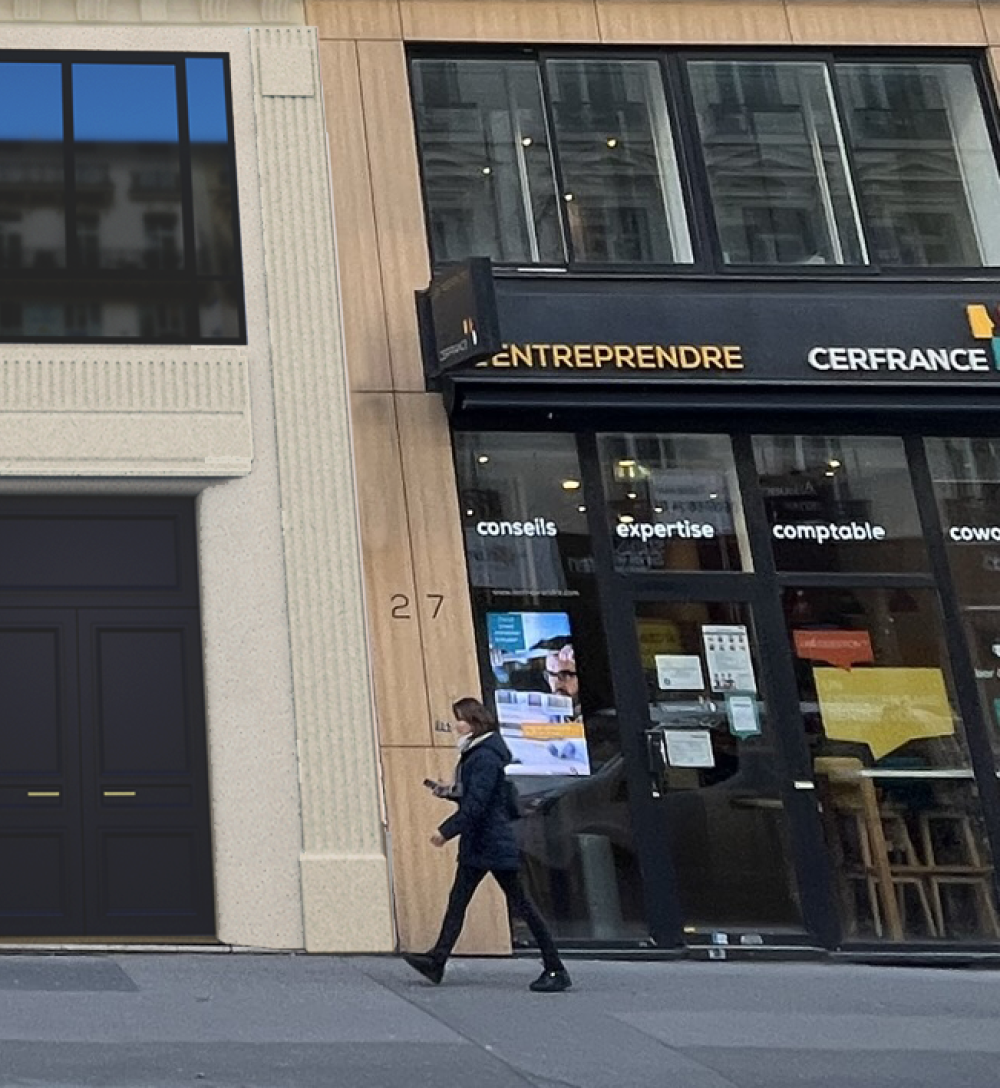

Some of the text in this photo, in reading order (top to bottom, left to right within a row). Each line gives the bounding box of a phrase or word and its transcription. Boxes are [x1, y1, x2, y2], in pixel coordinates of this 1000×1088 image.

[475, 343, 744, 369] ENTREPRENDRE
[807, 346, 990, 371] CERFRANCE
[476, 517, 558, 537] conseils
[615, 519, 715, 542] expertise
[772, 521, 886, 544] comptable
